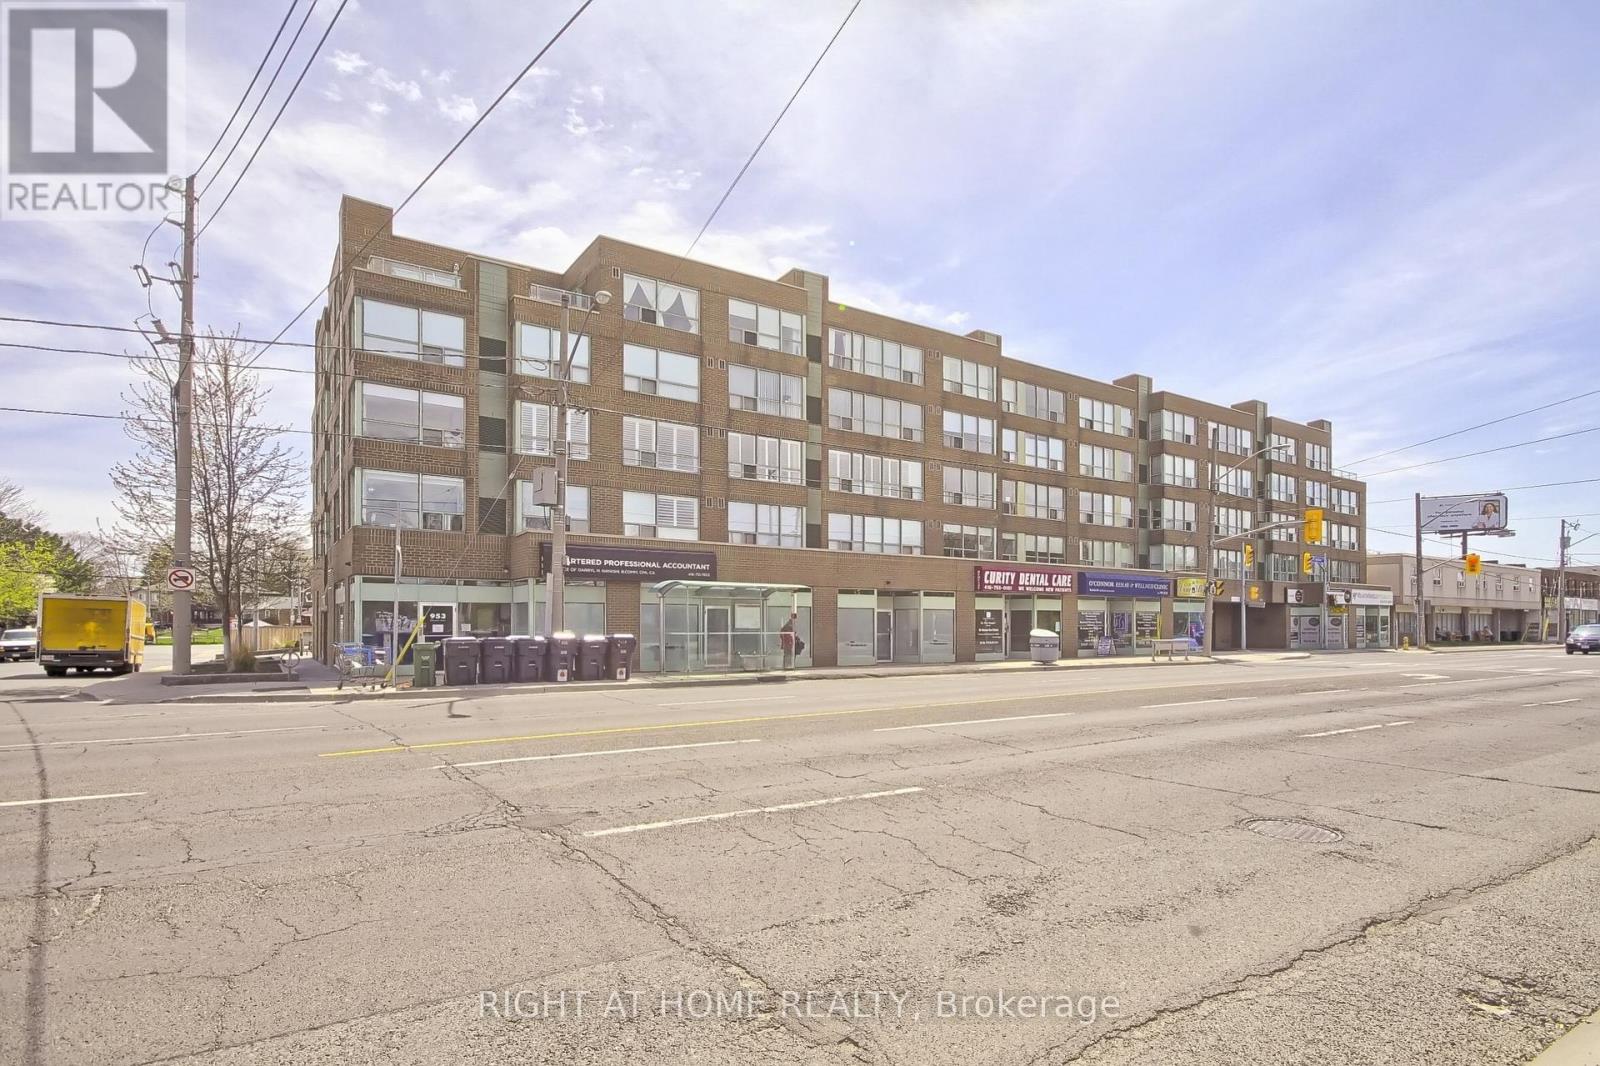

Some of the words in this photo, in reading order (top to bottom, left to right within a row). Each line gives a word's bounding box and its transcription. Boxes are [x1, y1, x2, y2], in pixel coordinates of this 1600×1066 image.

[603, 559, 661, 569] PROFESSIONAL
[662, 562, 710, 571] ACCOUNTANT
[984, 571, 1016, 585] CURITY
[1018, 572, 1049, 587] DENTAL
[1052, 574, 1072, 587] CARE
